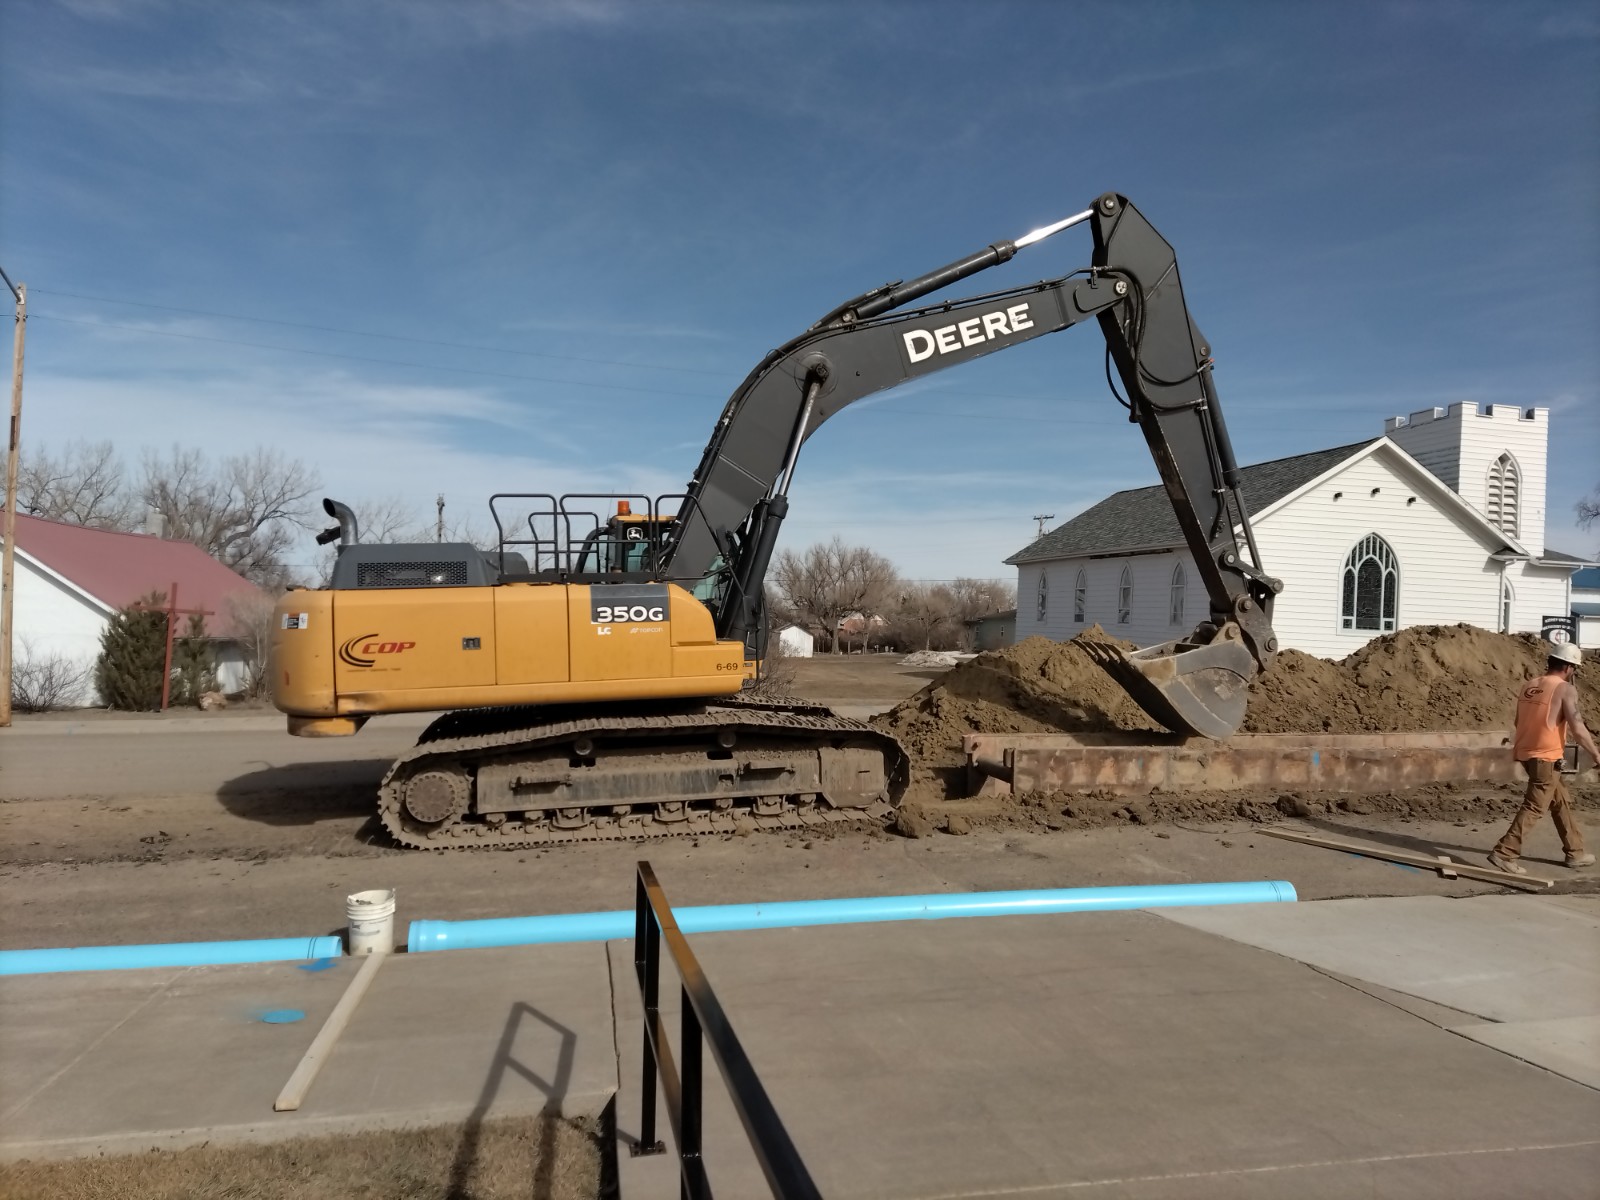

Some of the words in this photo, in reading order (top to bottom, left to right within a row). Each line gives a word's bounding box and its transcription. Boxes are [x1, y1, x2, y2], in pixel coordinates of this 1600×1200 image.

[903, 302, 1034, 363] DEERE
[596, 606, 663, 623] 350G
[597, 626, 612, 636] LC
[362, 641, 416, 655] COP
[716, 663, 738, 671] 6-69
